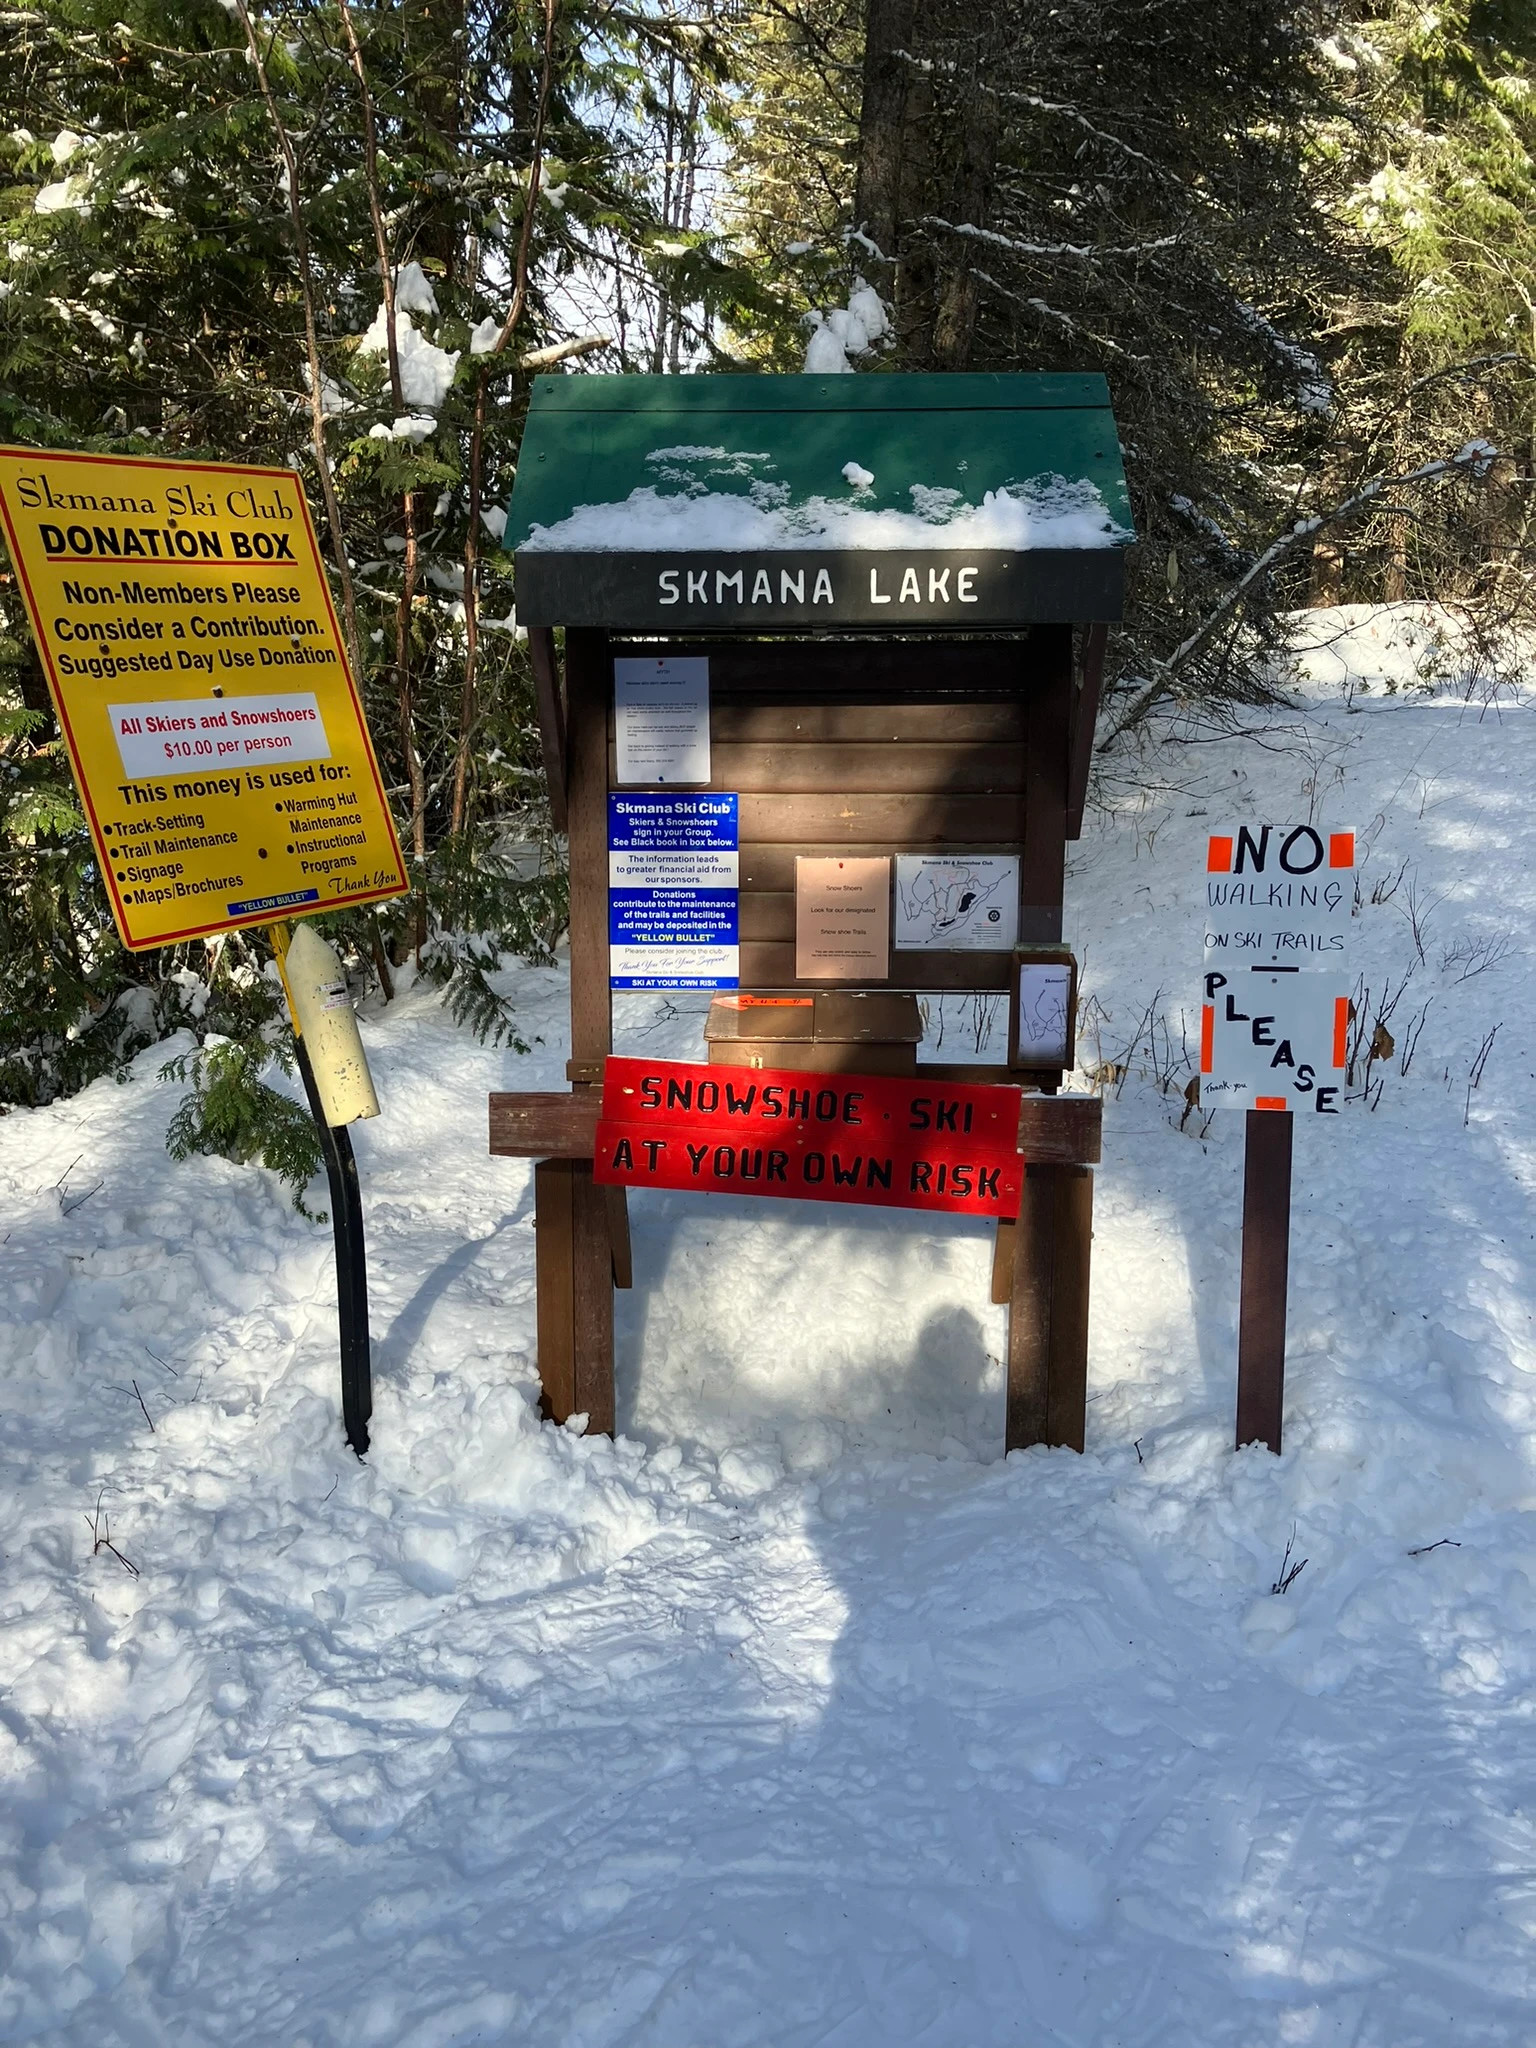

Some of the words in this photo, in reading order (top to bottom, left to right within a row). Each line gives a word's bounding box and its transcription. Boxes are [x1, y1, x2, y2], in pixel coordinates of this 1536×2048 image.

[16, 474, 158, 514] Skmana
[165, 484, 219, 517] Ski
[226, 488, 294, 520] Club
[39, 523, 226, 557] DONATION
[230, 531, 297, 560] BOX
[62, 581, 228, 605] Non-Members
[231, 582, 301, 603] Please
[658, 568, 834, 604] SKMANA
[869, 567, 979, 604] LAKE
[53, 617, 164, 642] Consider
[171, 621, 186, 639] a
[190, 615, 325, 639] Contribution.
[57, 650, 174, 679] Suggested
[177, 650, 215, 673] Day
[218, 648, 256, 669] Use
[258, 645, 337, 666] Donation
[120, 718, 142, 735] All
[146, 715, 196, 733] Skiers
[200, 711, 228, 729] and
[232, 707, 316, 726] Snowshoers
[164, 739, 213, 759] $10.00
[216, 739, 240, 756] per
[244, 734, 292, 754] person
[118, 783, 168, 806] This
[173, 776, 241, 801] money
[245, 772, 265, 790] is
[269, 765, 315, 787] used
[319, 763, 351, 781] for:
[283, 796, 336, 813] Warming
[336, 792, 358, 805] Hut
[616, 802, 673, 814] Skmana
[674, 802, 696, 814] Ski
[698, 802, 730, 814] Club
[113, 813, 205, 837] Track-Setting
[289, 813, 362, 834] Maintenance
[629, 818, 655, 826] Skiers
[658, 818, 664, 826] &
[666, 818, 718, 826] Snowshoers
[633, 828, 651, 837] sign
[654, 828, 661, 836] in
[664, 829, 683, 837] your
[685, 828, 714, 837] Group.
[120, 841, 151, 859] Trail
[154, 831, 239, 855] Maintenance
[295, 831, 367, 854] Instructional
[613, 838, 629, 846] See
[631, 838, 654, 846] Black
[656, 838, 677, 846] book
[680, 838, 687, 846] in
[690, 838, 705, 846] box
[707, 838, 735, 846] below.
[1233, 825, 1325, 875] NO
[301, 854, 357, 874] Programs
[626, 866, 656, 875] greater
[659, 865, 695, 873] financial
[696, 865, 709, 873] aid
[711, 865, 731, 873] from
[628, 855, 644, 863] The
[646, 855, 695, 863] information
[696, 855, 719, 863] leads
[127, 862, 184, 883] Signage
[328, 874, 370, 895] Thank
[373, 870, 397, 888] You
[660, 876, 702, 884] sponsors.
[133, 875, 244, 905] Maps/Brochures
[653, 890, 696, 899] Donations
[1207, 881, 1343, 912] WALKING
[238, 899, 275, 912] "YELLOW
[277, 892, 309, 905] BULLET"
[613, 900, 656, 908] contribute
[657, 900, 666, 908] to
[667, 900, 681, 908] the
[682, 900, 736, 908] maintenance
[618, 921, 634, 929] and
[635, 922, 653, 930] may
[654, 921, 664, 929] be
[666, 921, 708, 930] deposited
[709, 921, 717, 929] in
[718, 921, 732, 929] the
[623, 911, 632, 919] of
[634, 911, 648, 919] the
[649, 911, 670, 919] trails
[672, 911, 688, 919] and
[690, 911, 726, 919] facilities
[631, 934, 674, 942] "YELLOW
[676, 934, 715, 942] BULLET"
[1204, 932, 1229, 949] ON
[1234, 931, 1262, 949] SKI
[1271, 931, 1344, 952] TRAILS
[618, 962, 640, 972] Thank
[641, 960, 658, 972] You
[660, 958, 673, 968] For
[675, 957, 695, 969] Your
[1203, 972, 1340, 1114] PLEASE
[640, 1076, 865, 1126] SNOWSHOE
[909, 1097, 974, 1135] SKI
[611, 1138, 667, 1173] AT
[686, 1142, 790, 1184] YOUR
[803, 1152, 894, 1191] OWN
[909, 1160, 1002, 1200] RISK
